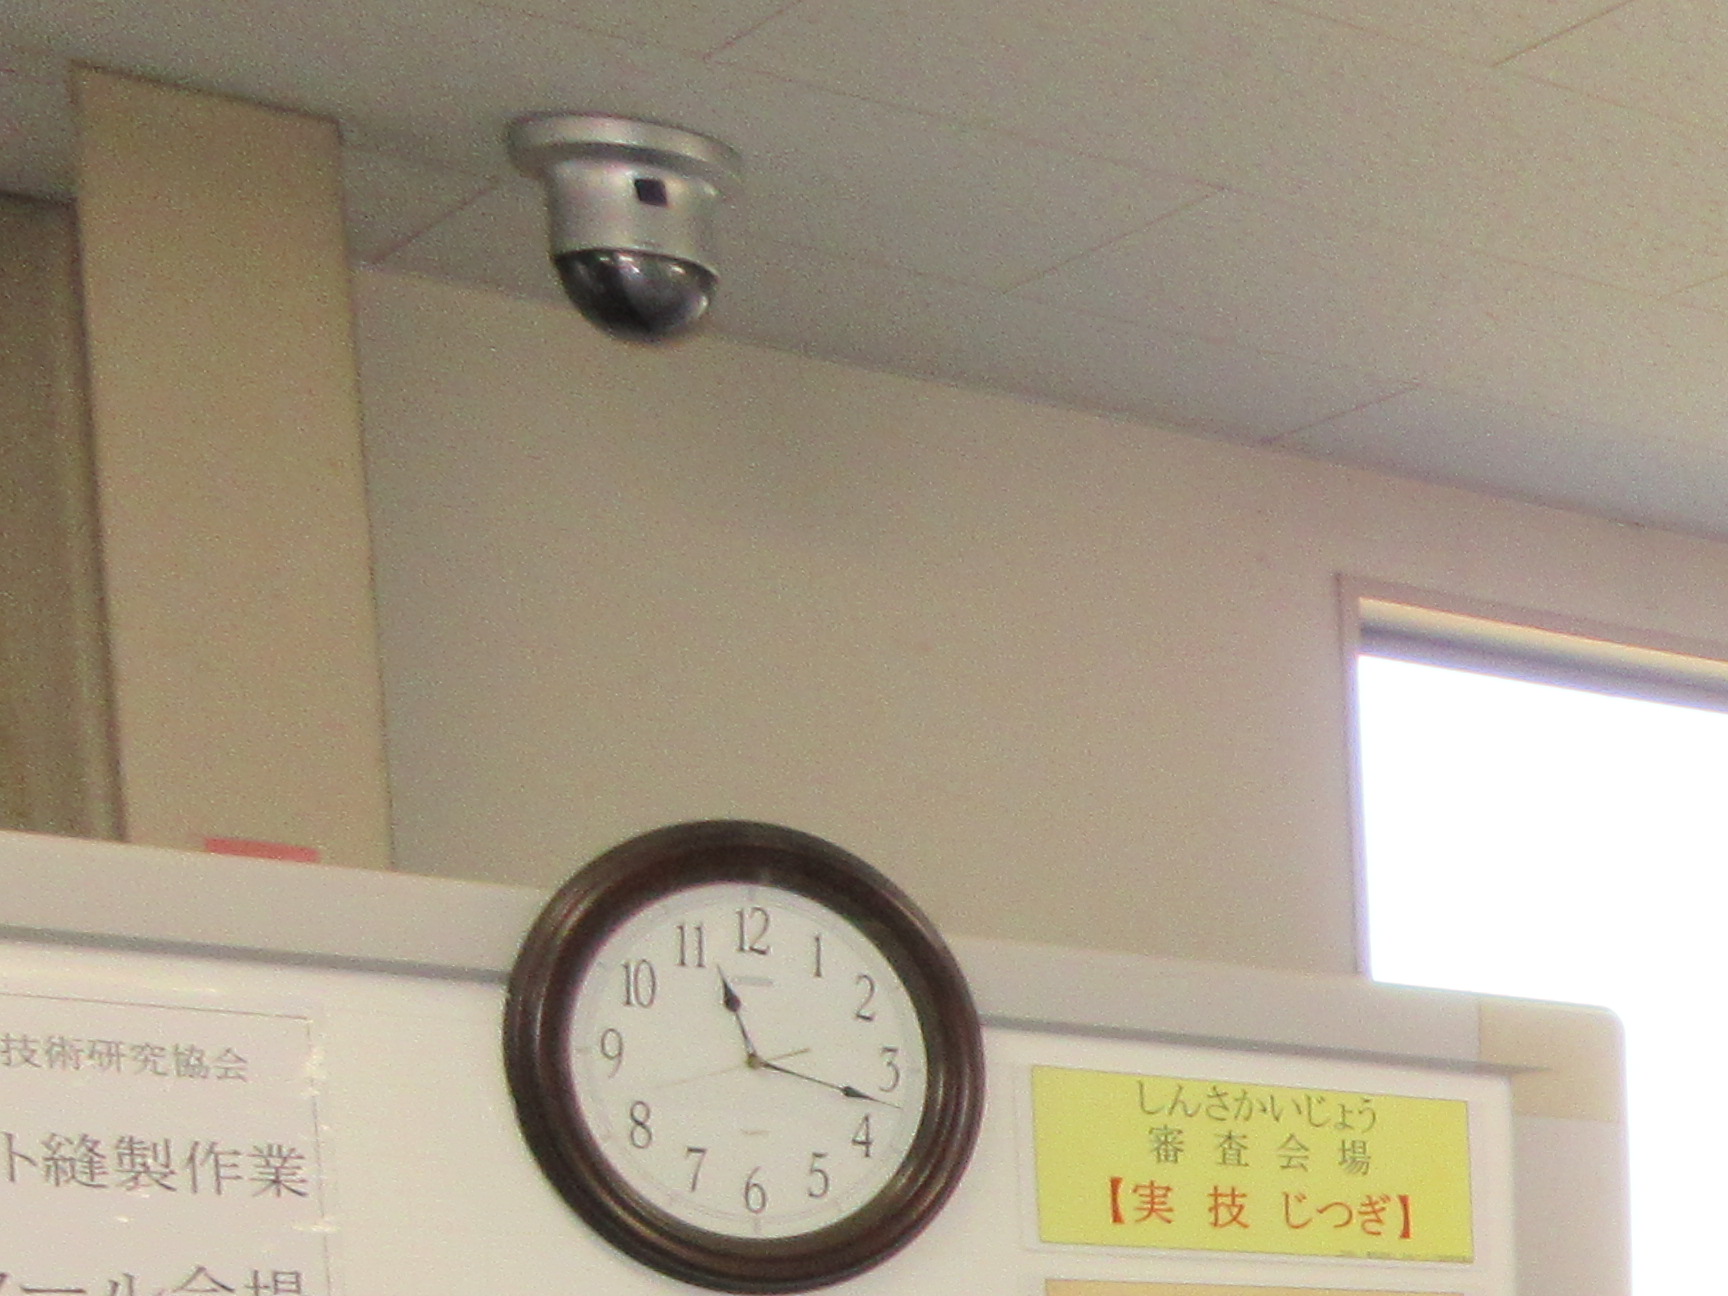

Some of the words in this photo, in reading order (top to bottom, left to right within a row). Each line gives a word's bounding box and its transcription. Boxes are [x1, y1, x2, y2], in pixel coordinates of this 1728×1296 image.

[676, 921, 706, 968] 11
[736, 906, 771, 955] 12
[812, 933, 823, 977] 1
[622, 959, 657, 1009] 10
[855, 974, 876, 1022] 2
[0, 1033, 248, 1083] 技術研究協会
[600, 1028, 624, 1078] 9
[879, 1047, 900, 1092] 3
[630, 1101, 653, 1149] 8
[1136, 1080, 1378, 1133] しんさかいじょう
[851, 1114, 873, 1159] 4
[1149, 1124, 1373, 1176] 審査会場
[0, 1131, 309, 1198] ト縫製作業
[686, 1147, 707, 1192] 7
[808, 1152, 830, 1199] 5
[744, 1166, 767, 1214] 6
